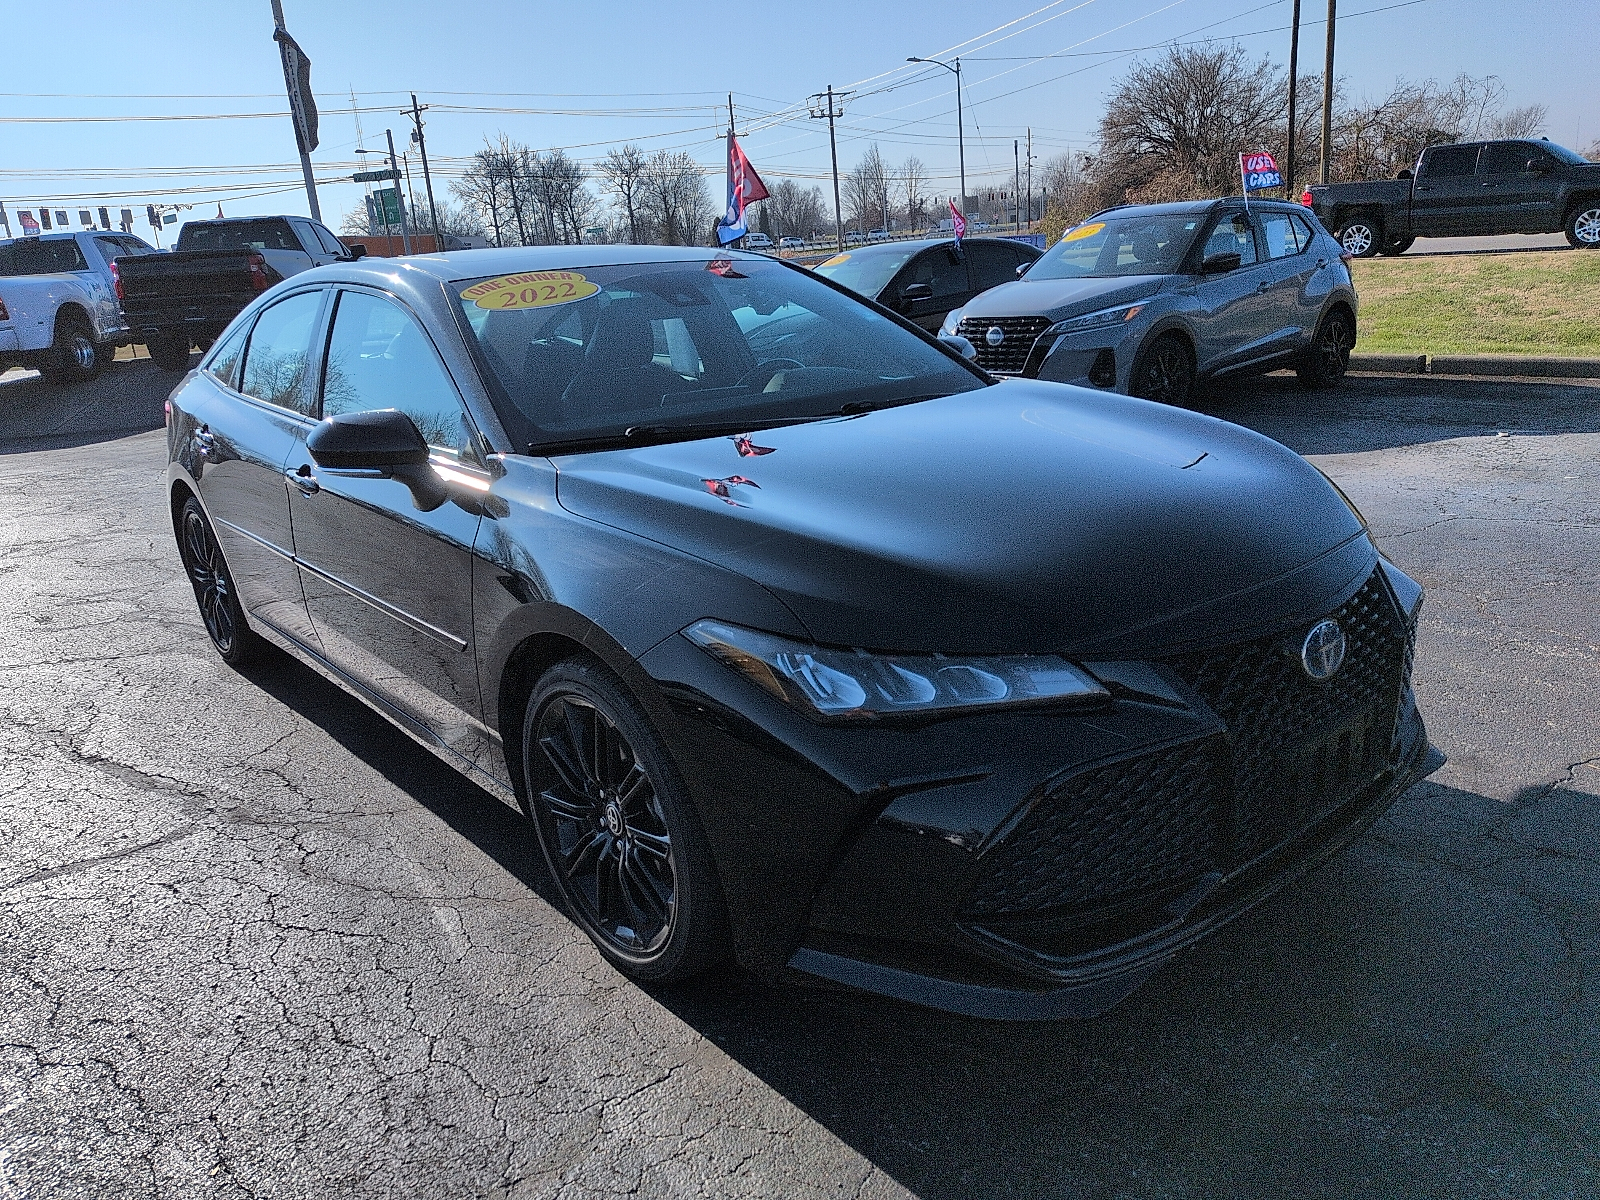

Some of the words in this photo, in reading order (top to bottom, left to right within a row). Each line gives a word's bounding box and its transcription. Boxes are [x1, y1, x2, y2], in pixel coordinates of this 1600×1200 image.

[1249, 172, 1280, 187] CARS
[467, 280, 506, 296] ONE
[504, 271, 573, 286] OWNER
[499, 282, 577, 308] 2022
